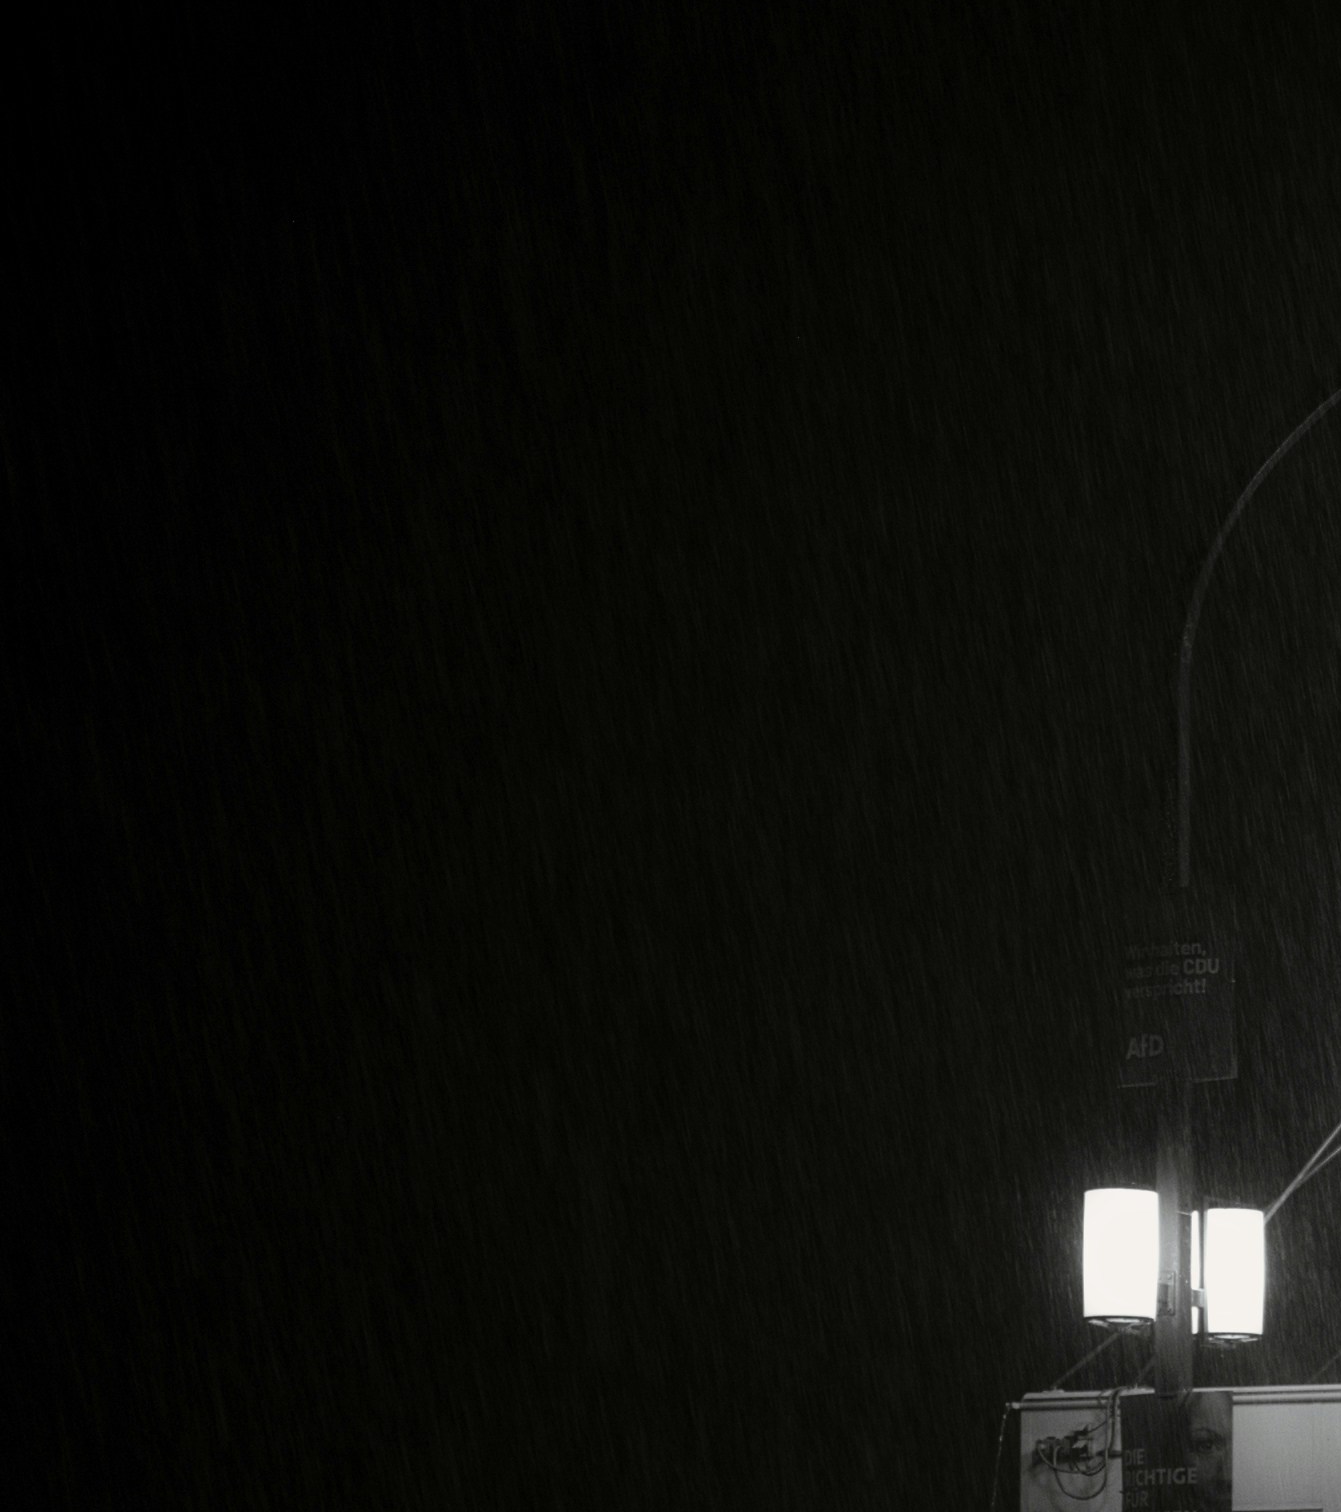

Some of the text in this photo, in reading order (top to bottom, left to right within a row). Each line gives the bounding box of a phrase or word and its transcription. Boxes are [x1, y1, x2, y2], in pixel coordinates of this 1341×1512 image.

[1183, 957, 1220, 975] CDU
[1126, 1033, 1164, 1060] AfD
[1125, 1448, 1145, 1466] DIE
